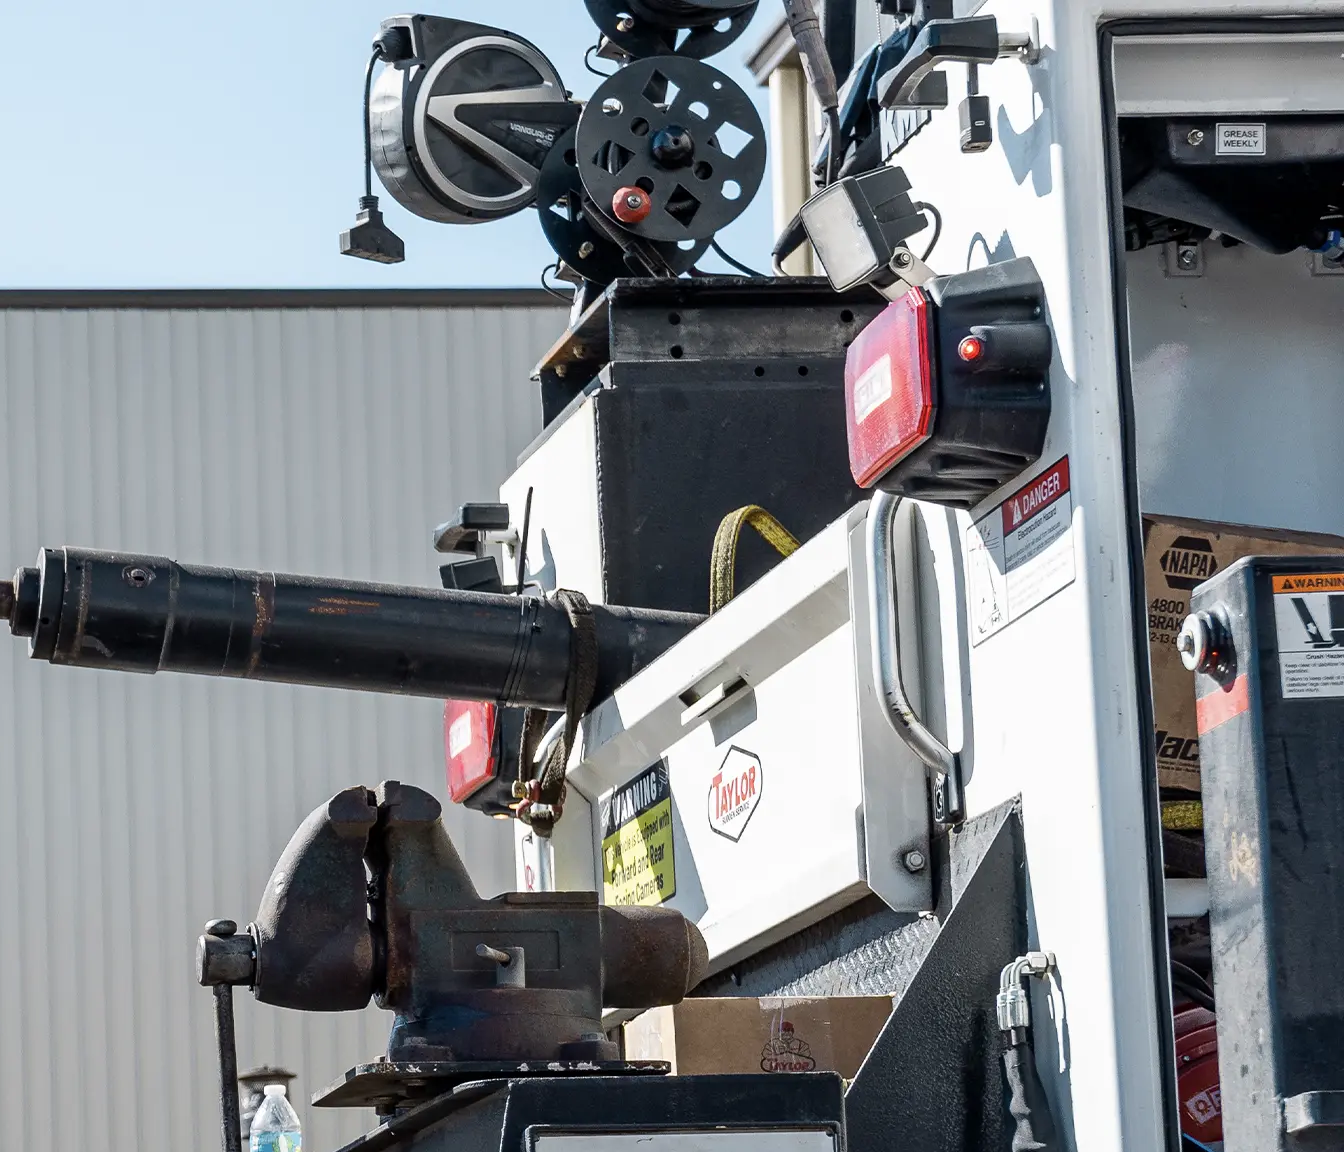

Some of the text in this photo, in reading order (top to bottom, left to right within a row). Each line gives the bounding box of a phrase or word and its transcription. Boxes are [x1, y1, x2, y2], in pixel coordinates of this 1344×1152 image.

[1223, 130, 1259, 138] GREASE
[1223, 140, 1258, 148] WEEKLY
[1023, 471, 1060, 515] DANGER
[1169, 550, 1209, 577] NAPA
[1150, 598, 1185, 615] 4800
[612, 771, 657, 825] WARNING
[712, 765, 756, 820] TAYLOR
[659, 808, 670, 830] with
[650, 842, 665, 866] Rear
[635, 873, 664, 901] Cameras
